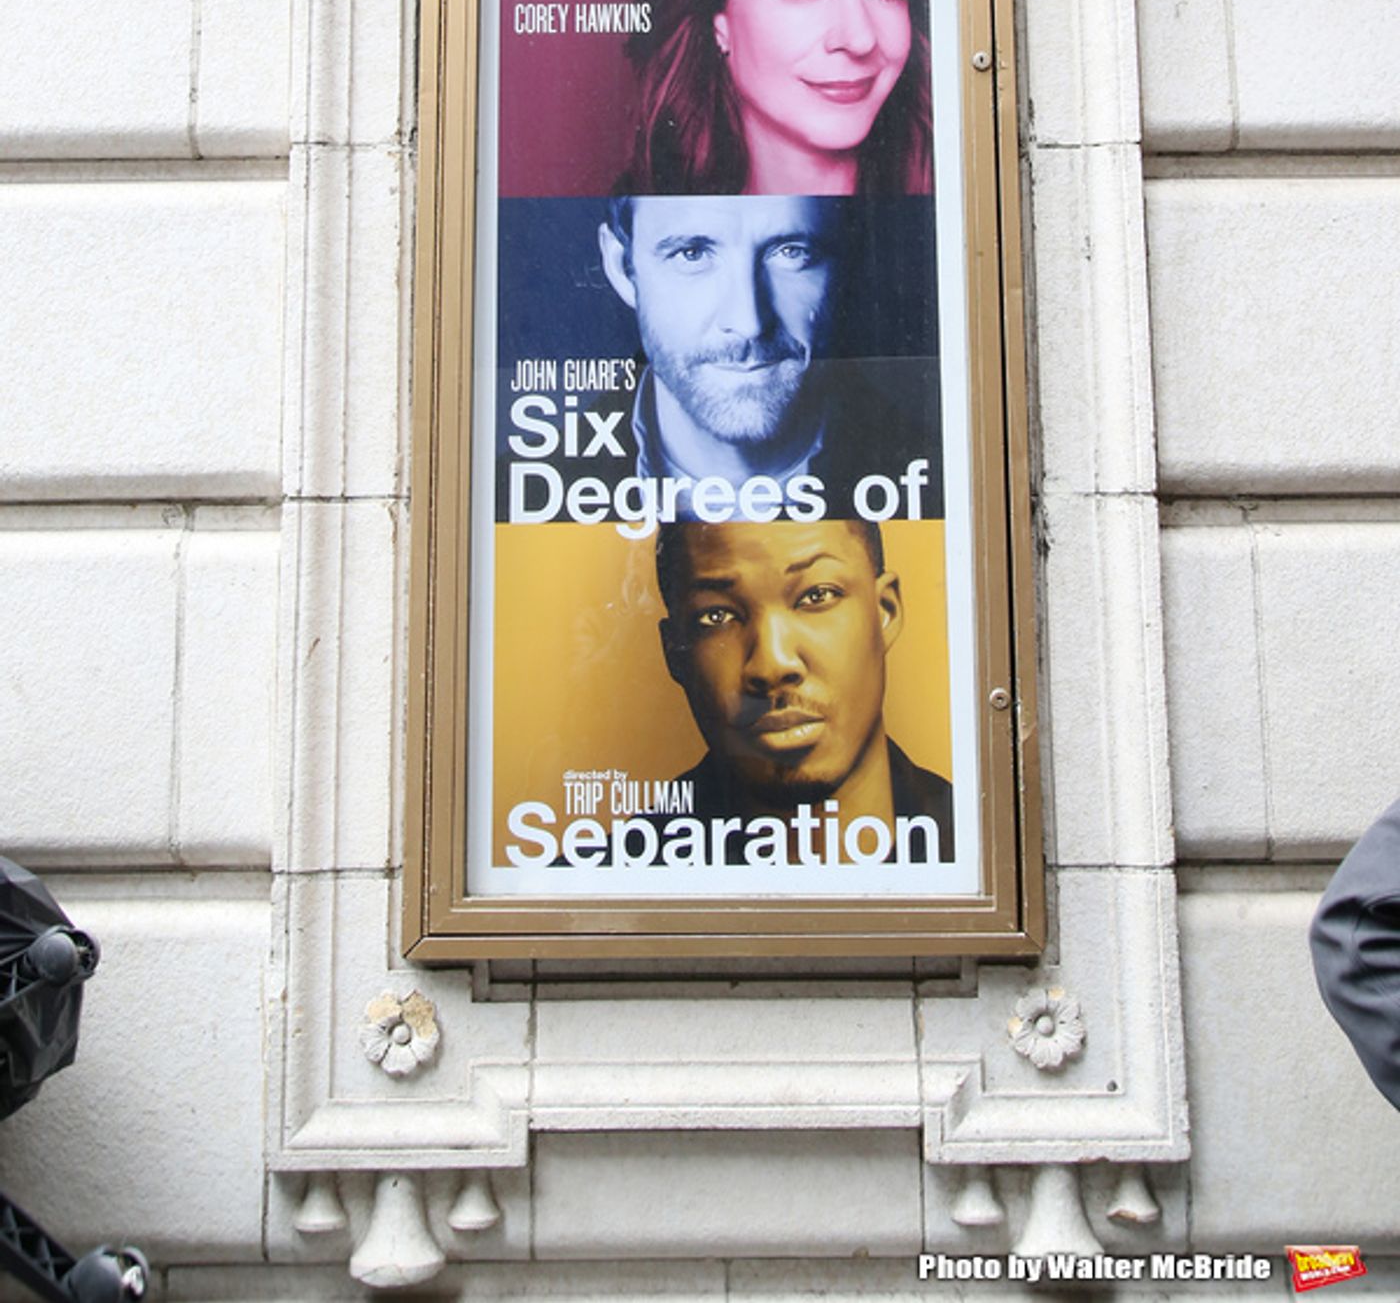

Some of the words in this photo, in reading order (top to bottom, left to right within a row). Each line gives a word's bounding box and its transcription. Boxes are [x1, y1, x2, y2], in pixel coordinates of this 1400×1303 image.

[514, 3, 570, 34] COREY
[575, 2, 652, 33] HAWKINS
[510, 359, 557, 392] JOHN
[564, 357, 636, 392] GUARE'S
[508, 394, 627, 458] Six
[508, 462, 827, 540] Degrees
[853, 458, 928, 524] of
[563, 769, 611, 780] directed
[613, 769, 629, 783] by
[563, 781, 604, 815] TRIP
[611, 780, 694, 815] CULLMAN
[504, 799, 940, 868] Separation
